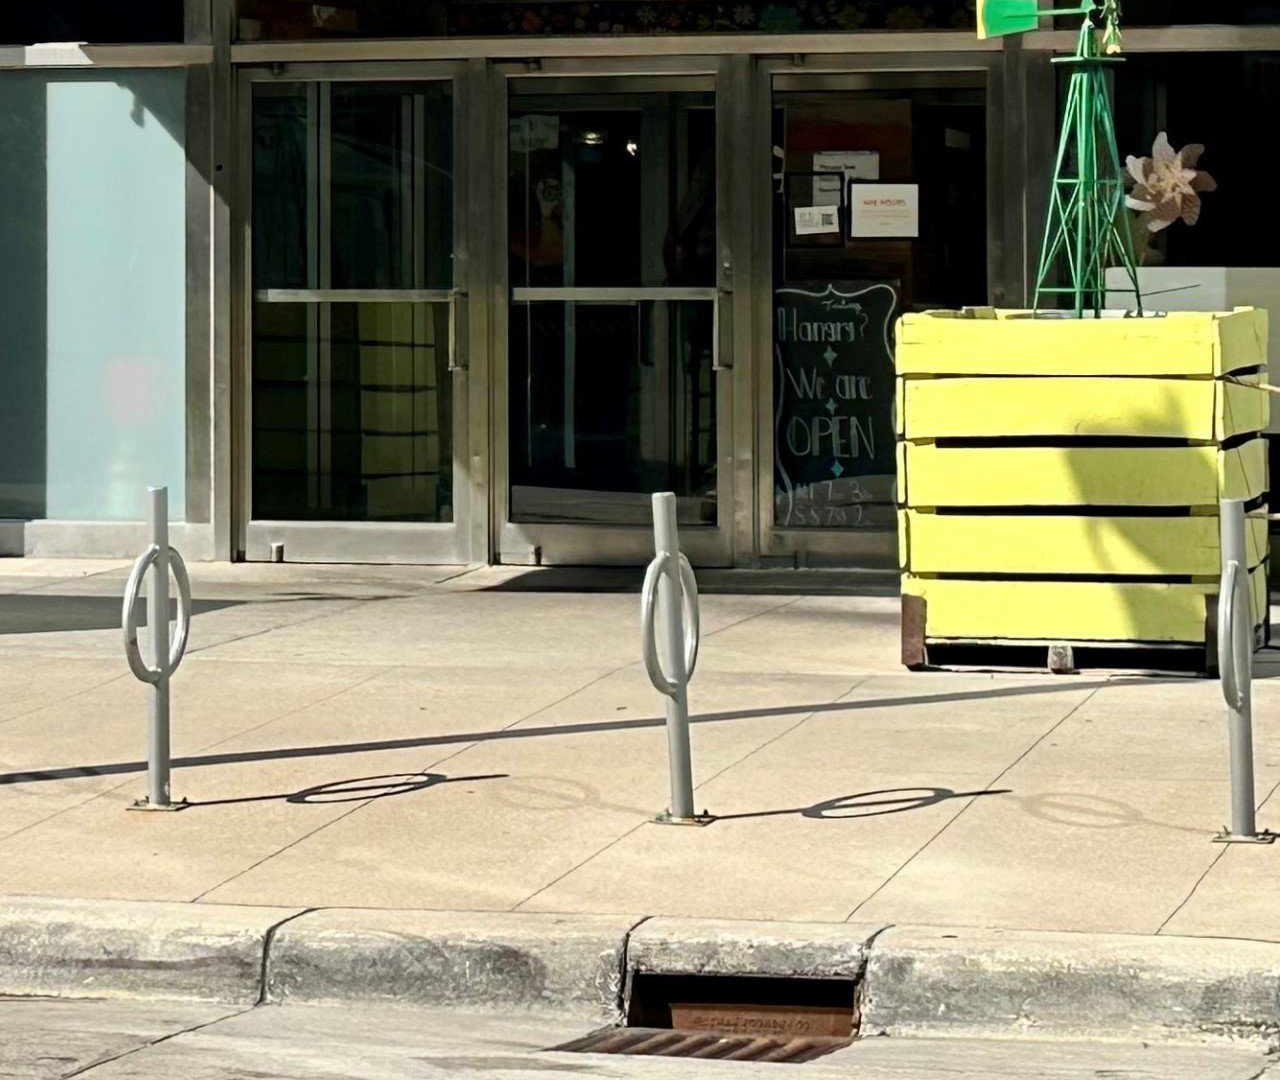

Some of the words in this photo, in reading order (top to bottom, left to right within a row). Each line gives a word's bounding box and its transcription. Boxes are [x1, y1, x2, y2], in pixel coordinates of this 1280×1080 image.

[786, 366, 825, 401] We
[835, 375, 873, 400] are
[786, 415, 875, 460] OPEN
